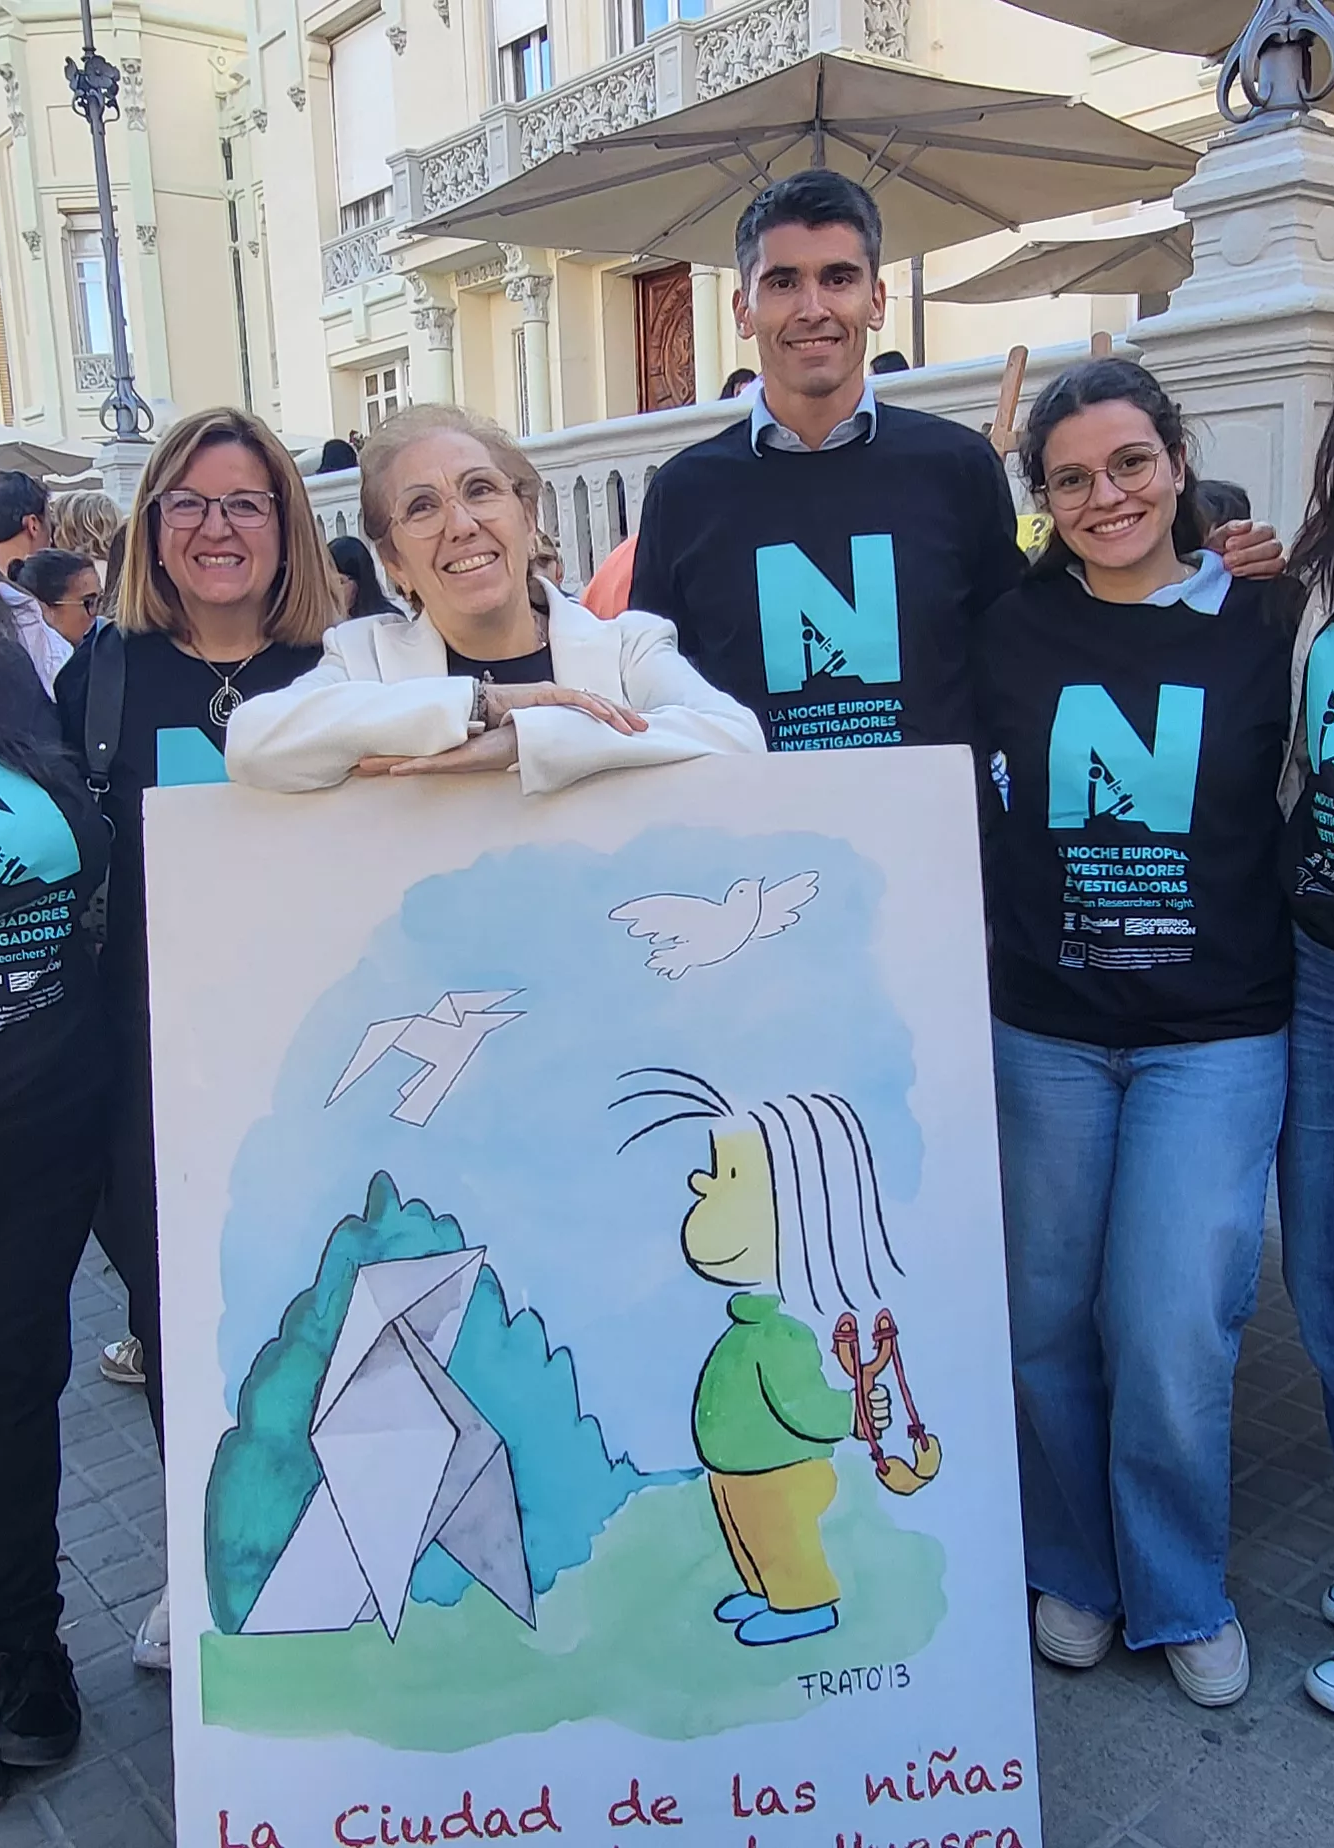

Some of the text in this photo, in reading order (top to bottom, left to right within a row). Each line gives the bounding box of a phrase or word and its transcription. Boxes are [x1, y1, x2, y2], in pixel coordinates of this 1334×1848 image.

[756, 533, 902, 694] N
[788, 703, 836, 720] NOCHE
[838, 700, 903, 715] EUROPEA
[779, 715, 897, 737] INVESTIGADORES
[781, 731, 903, 752] INVESTIGADORAS
[1048, 684, 1205, 833] N
[1067, 847, 1120, 859] NOCHE
[1165, 898, 1194, 911] Night
[219, 1746, 1023, 1848] La Ciudad de las niñas
